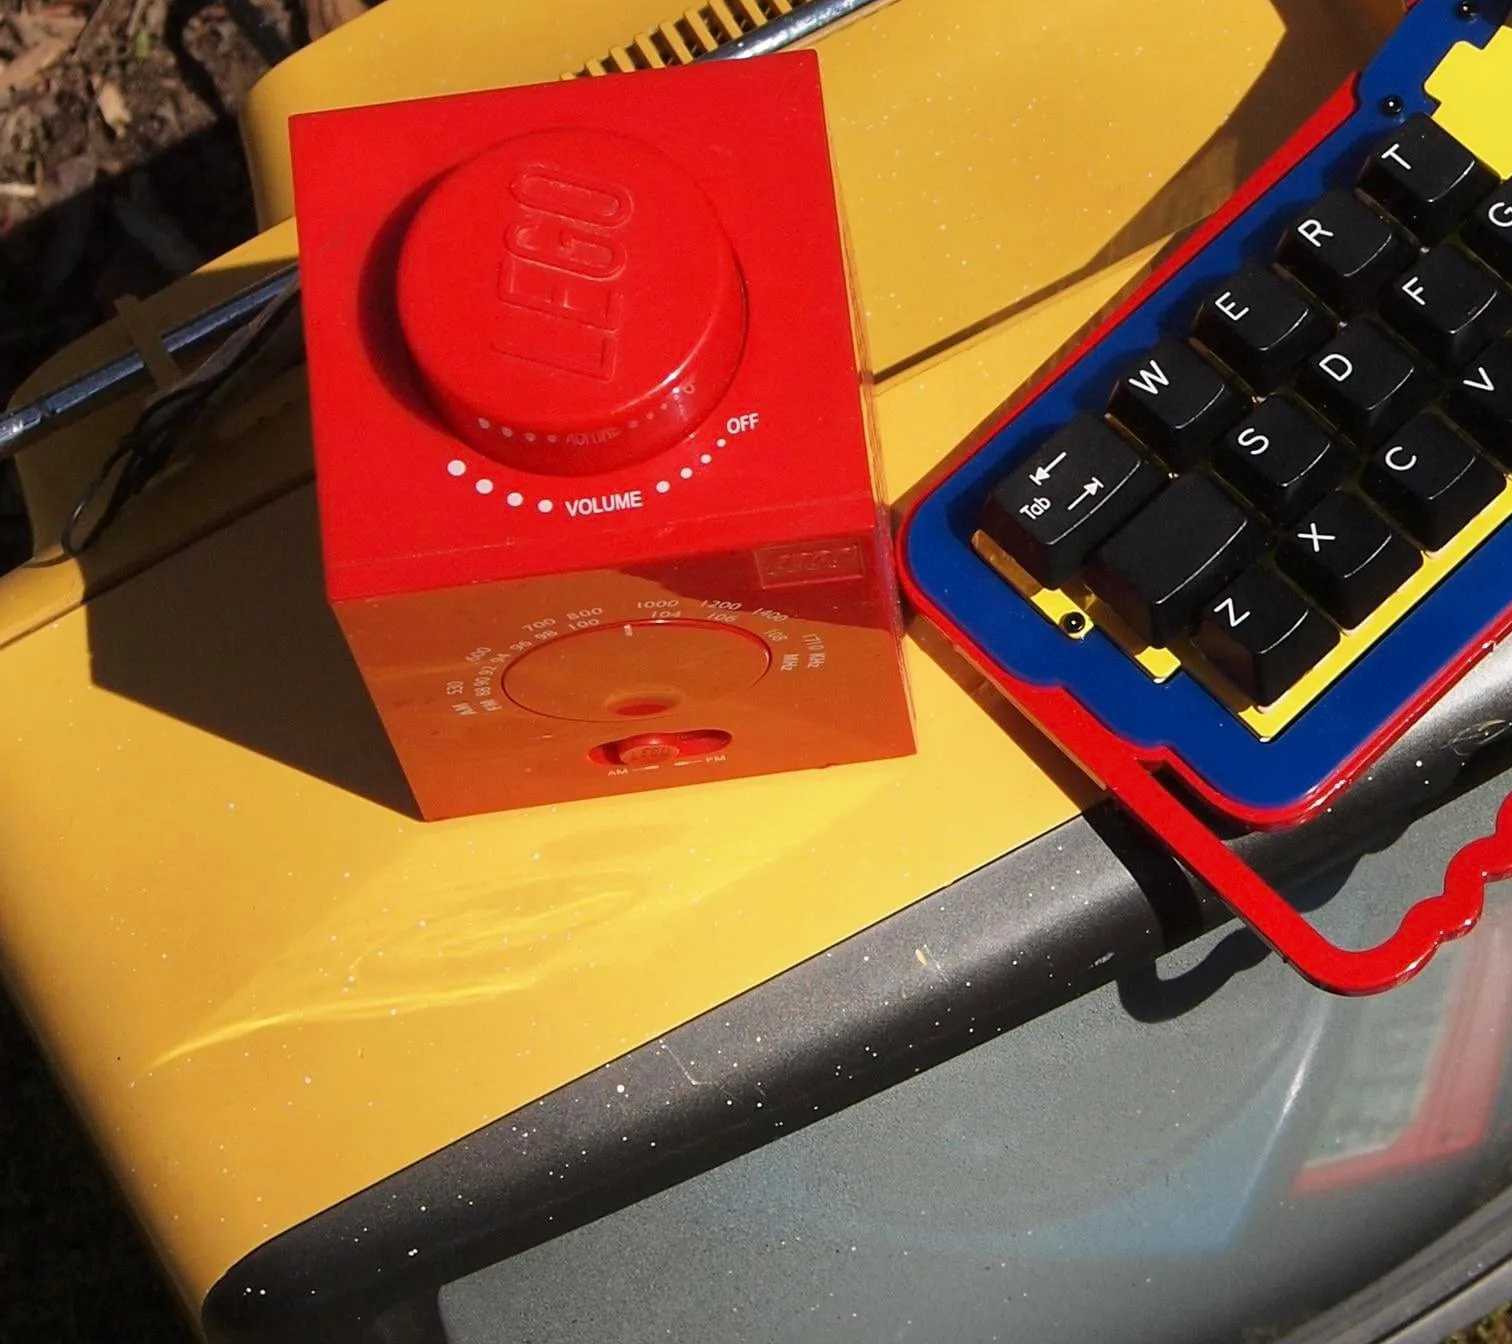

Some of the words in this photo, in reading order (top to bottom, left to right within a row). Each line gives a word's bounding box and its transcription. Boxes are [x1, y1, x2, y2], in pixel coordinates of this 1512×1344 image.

[1381, 143, 1412, 170] T
[1297, 219, 1334, 247] R
[489, 162, 634, 384] LEGO
[1401, 276, 1426, 306] F
[1214, 291, 1249, 321] E
[1128, 359, 1170, 395] W
[1318, 353, 1353, 382] D
[1463, 366, 1495, 391] V
[726, 413, 759, 435] OFF
[1237, 427, 1269, 455] S
[1385, 446, 1417, 471] C
[565, 490, 643, 517] VOLUME
[1019, 497, 1051, 519] Tab
[1297, 522, 1336, 553] X
[568, 618, 600, 630] 100
[707, 613, 737, 623] 106
[1213, 597, 1251, 627] Z
[509, 640, 532, 651] 96
[534, 629, 558, 640] 98
[452, 702, 478, 715] AM
[522, 618, 556, 632] 700
[566, 607, 602, 620] 800
[637, 599, 680, 609] 1000
[701, 599, 742, 611] 1200
[752, 608, 789, 622] 1400
[802, 634, 824, 650] 1710
[489, 653, 511, 663] 94
[474, 686, 491, 696] 88
[480, 699, 502, 711] FM
[705, 754, 727, 764] FM
[607, 767, 629, 777] AM
